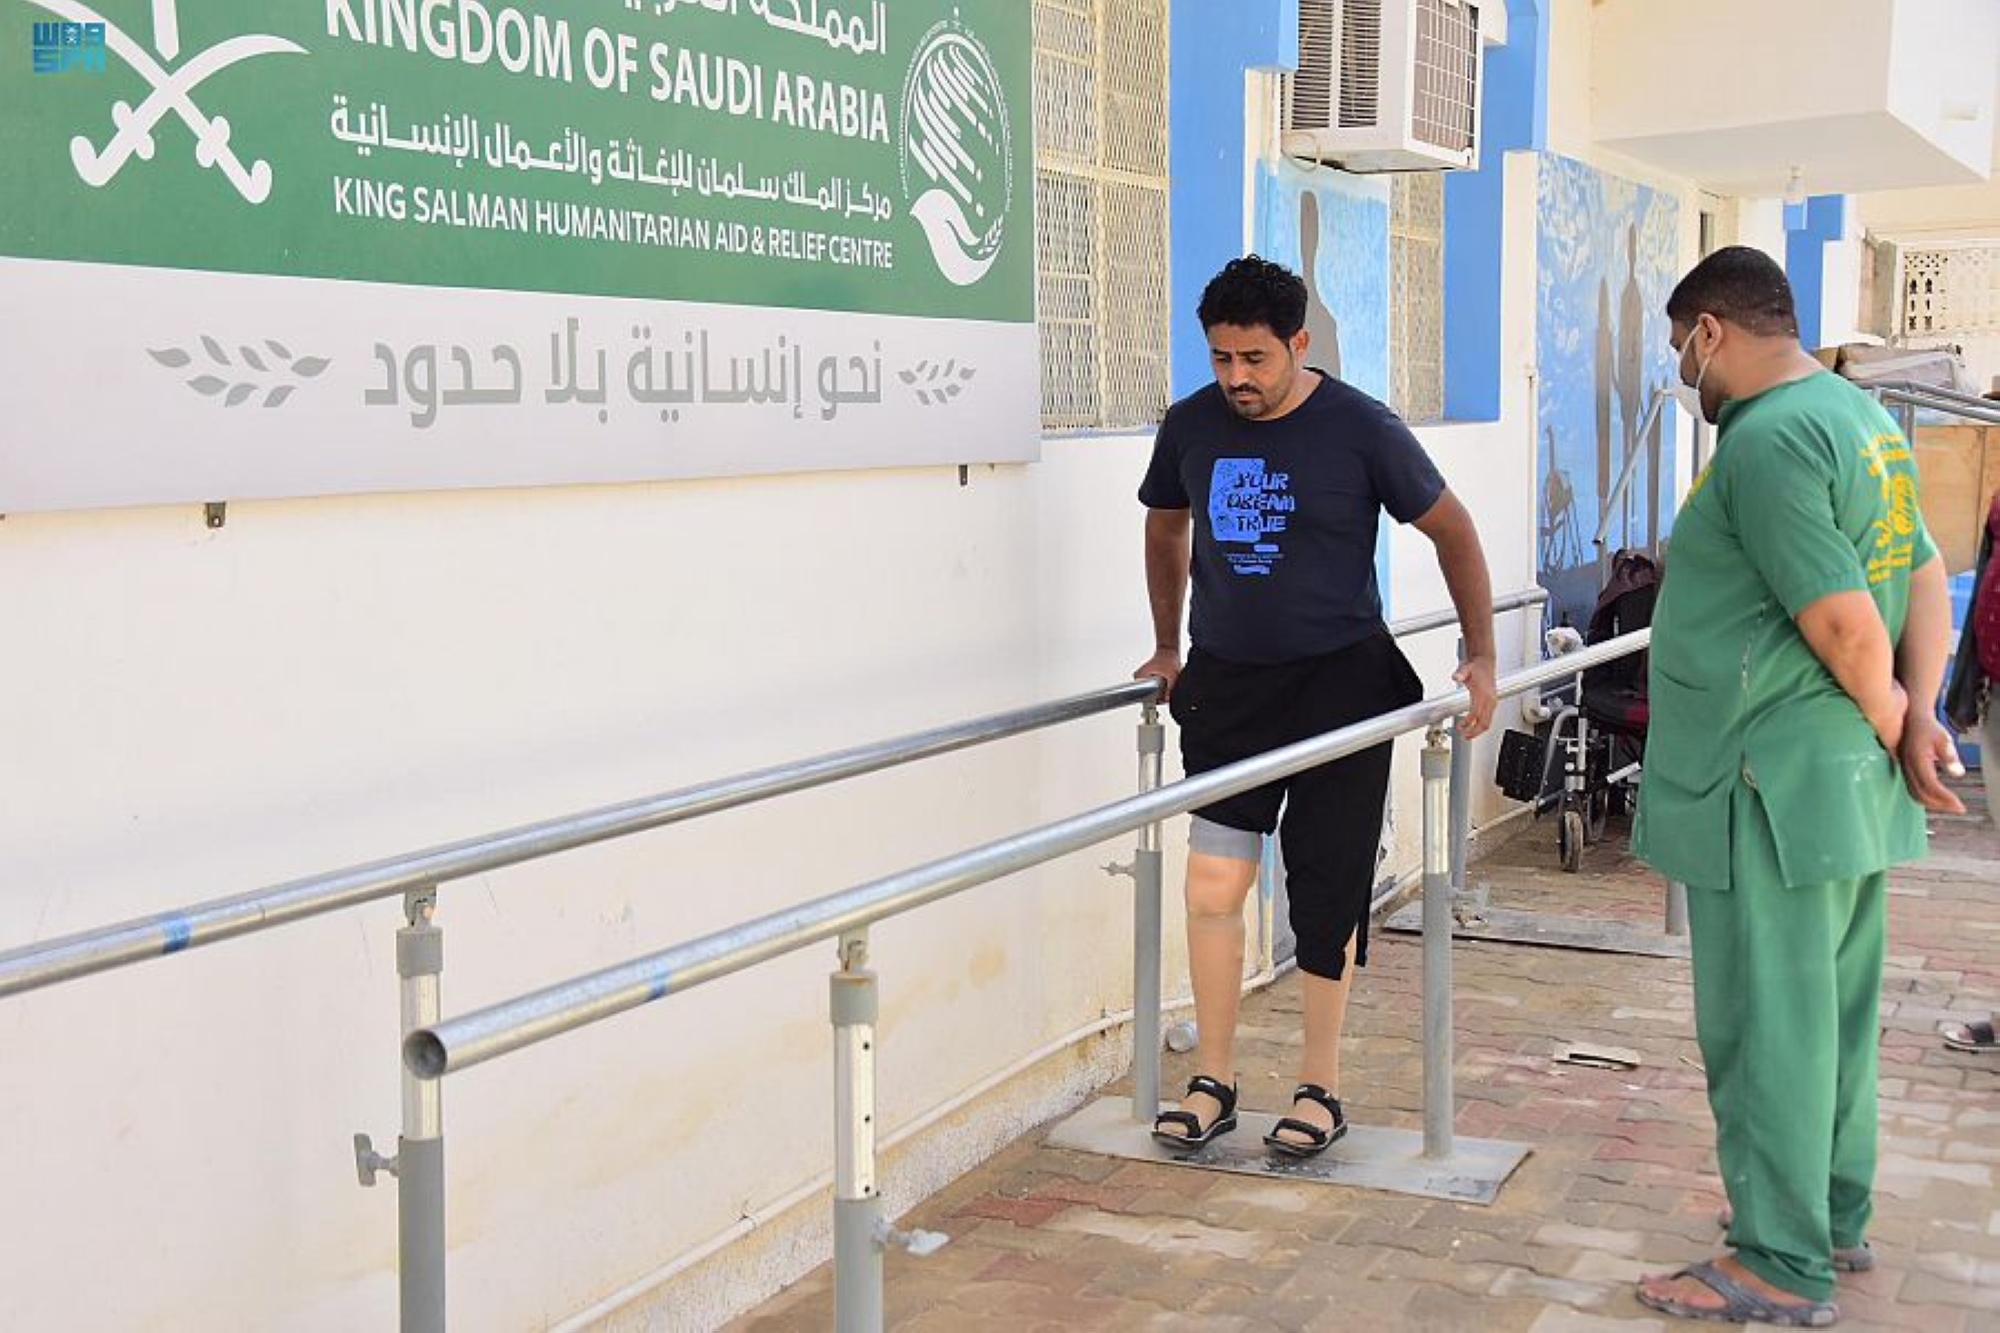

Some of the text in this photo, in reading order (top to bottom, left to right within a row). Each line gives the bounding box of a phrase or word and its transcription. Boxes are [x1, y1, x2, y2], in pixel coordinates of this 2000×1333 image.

[325, 0, 572, 82] KINGDOM
[584, 27, 638, 93] OF
[649, 42, 763, 119] SAUDI
[771, 69, 890, 144] ARABIA
[331, 95, 892, 222] مركز الملك سلمان للإغاثة والأعمال الإنسانية
[334, 176, 893, 268] KING SALMAN HUMANITARIAN AID & RELIEF CENTRE
[365, 317, 882, 428] نحو إنسانية بلا حدود
